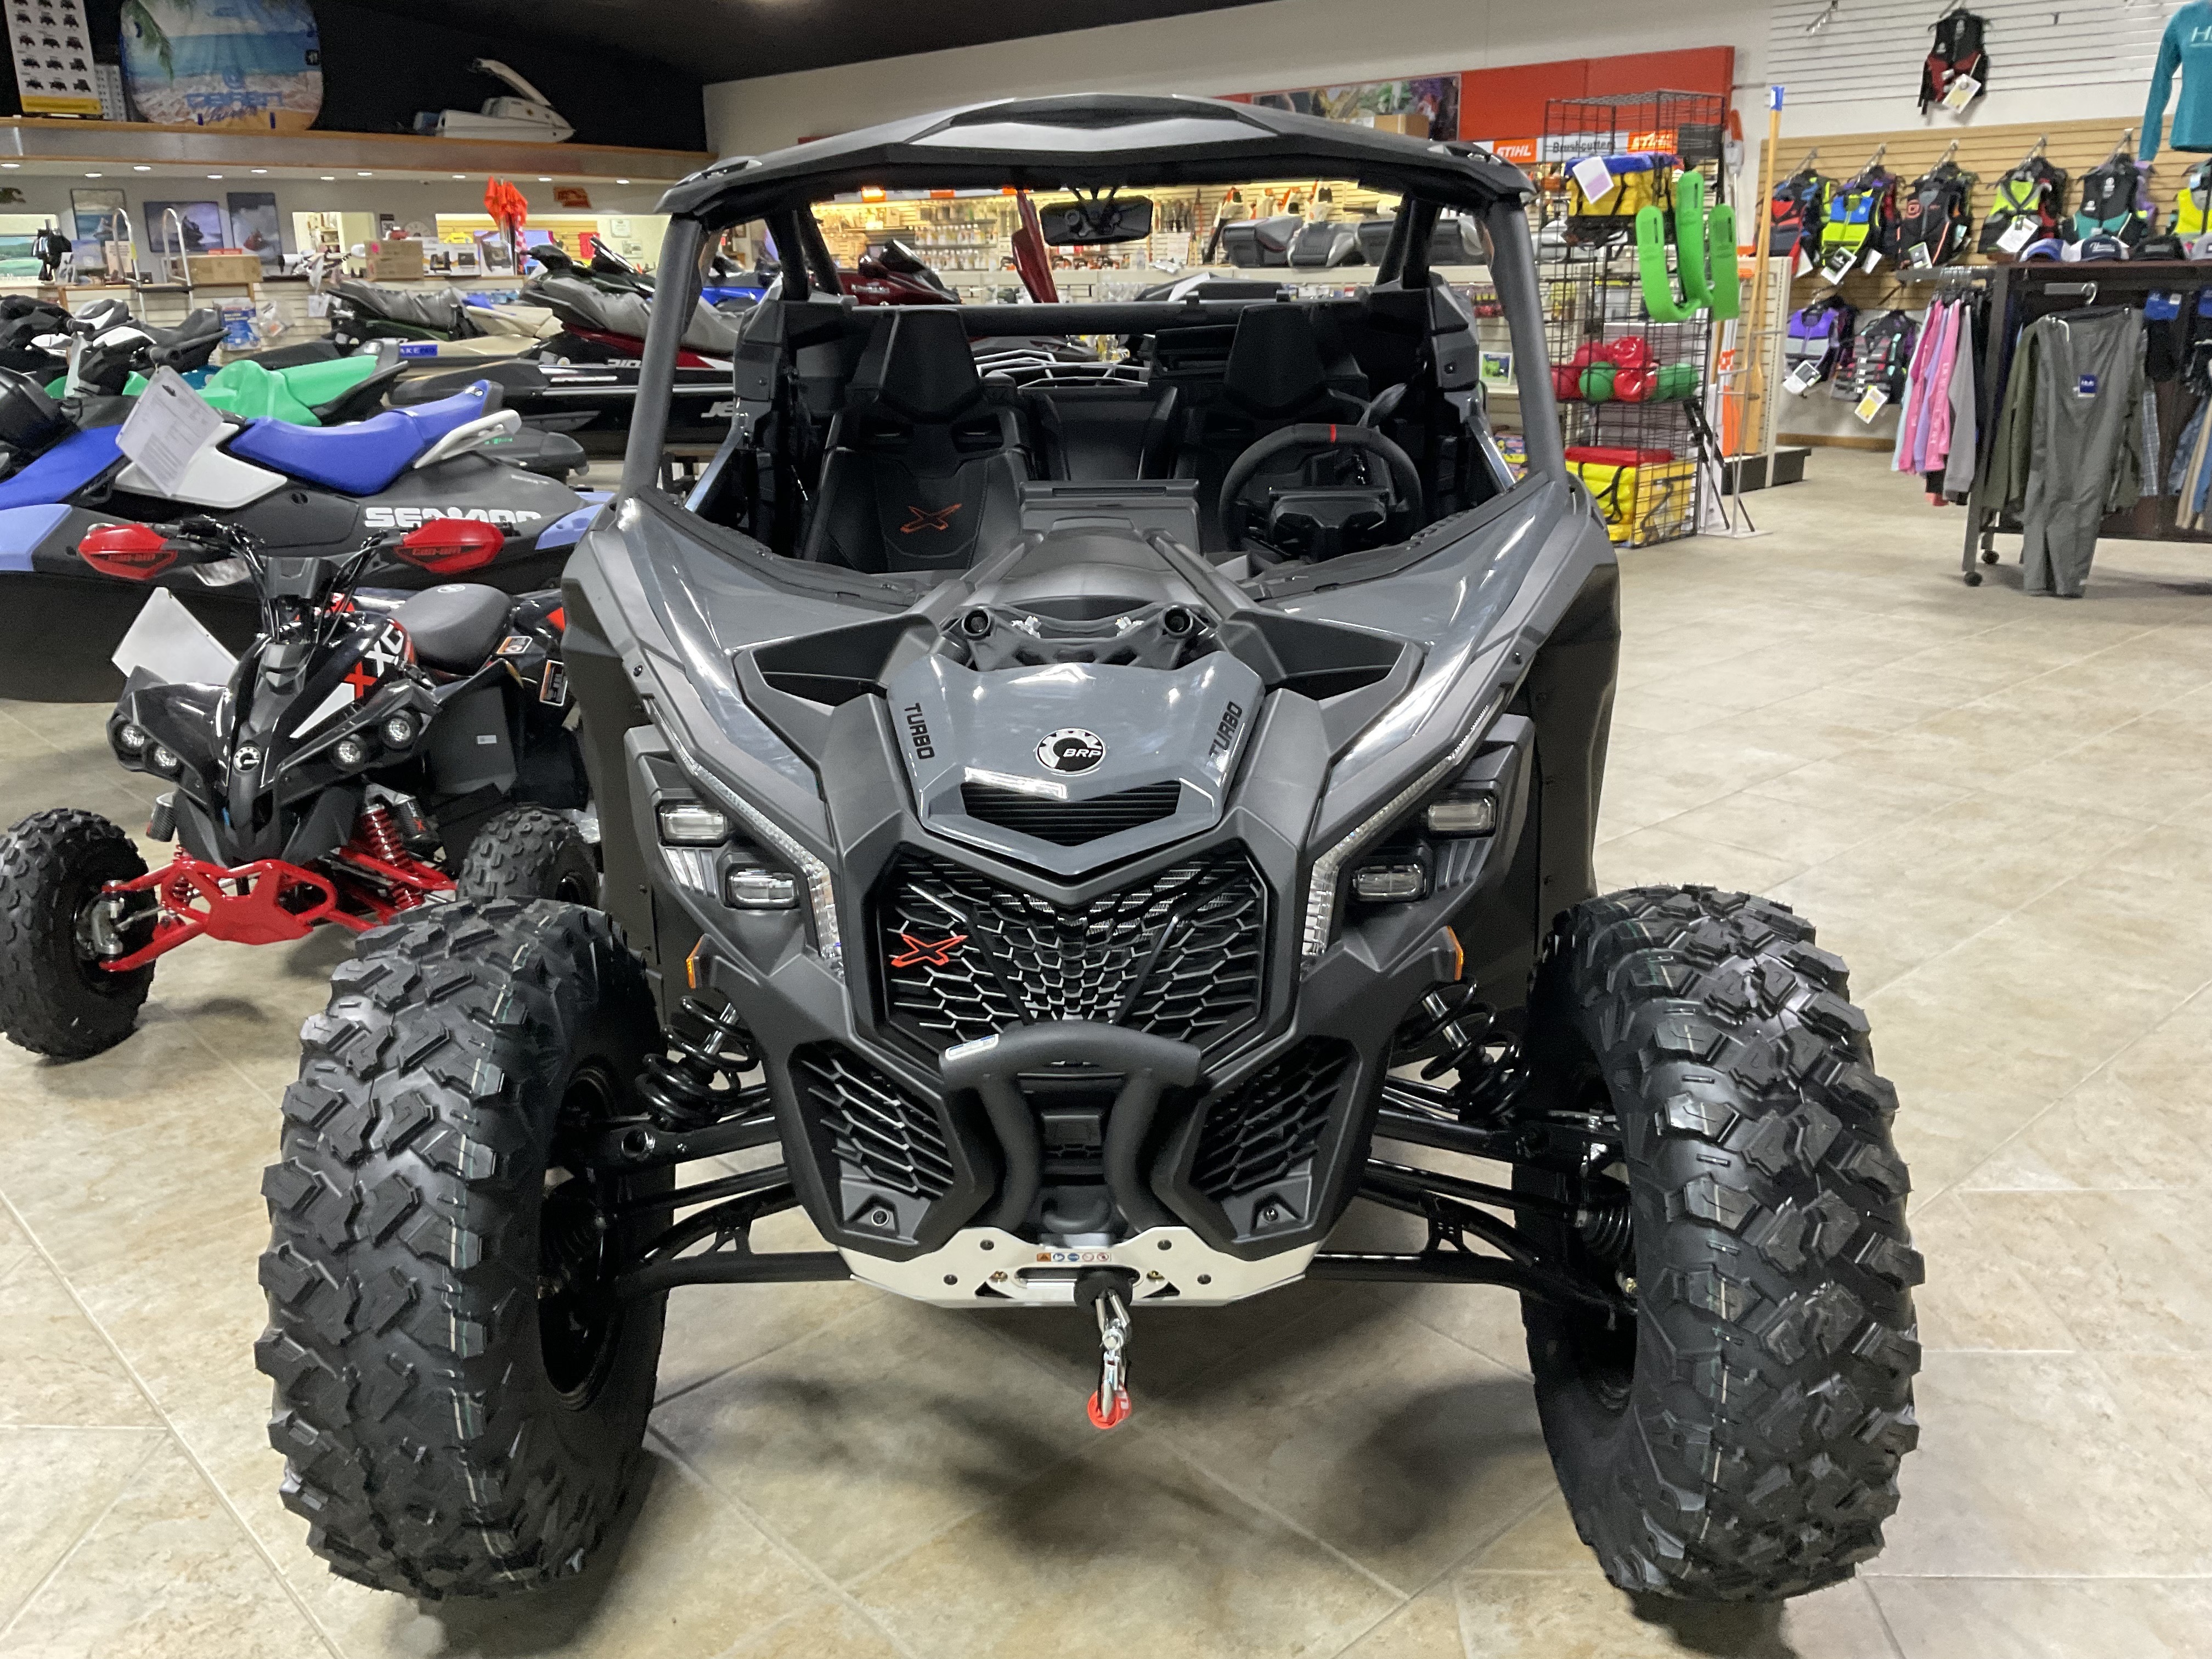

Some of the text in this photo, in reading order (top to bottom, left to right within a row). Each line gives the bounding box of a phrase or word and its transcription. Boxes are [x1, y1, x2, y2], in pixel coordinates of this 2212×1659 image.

[1497, 145, 1532, 157] STIHL
[905, 702, 935, 759] TURBO
[1209, 701, 1243, 758] TURBO
[1063, 748, 1102, 758] BRP
